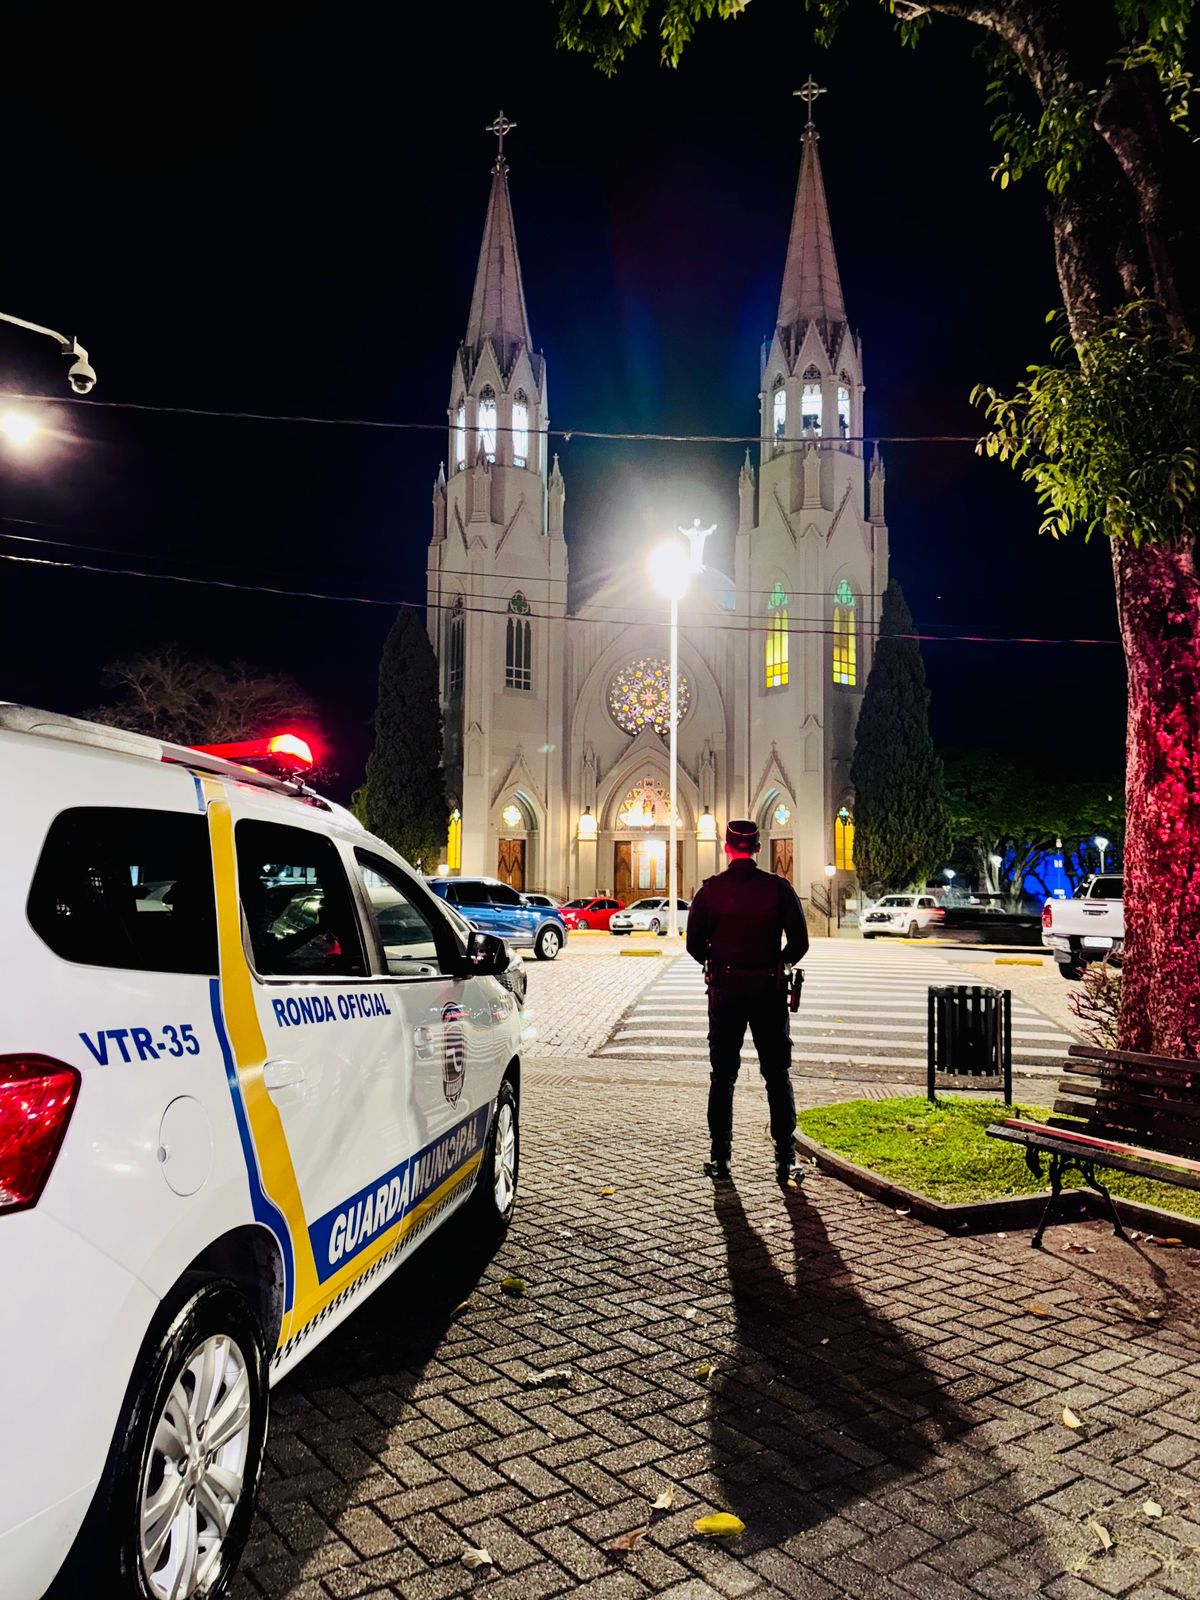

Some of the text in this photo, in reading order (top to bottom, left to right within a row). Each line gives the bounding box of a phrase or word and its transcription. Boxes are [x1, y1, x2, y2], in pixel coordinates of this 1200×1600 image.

[271, 993, 391, 1027] RONDA OFICIAL
[78, 1024, 201, 1066] VTR-35
[328, 1117, 478, 1265] GUARDA MUNICIPAL
